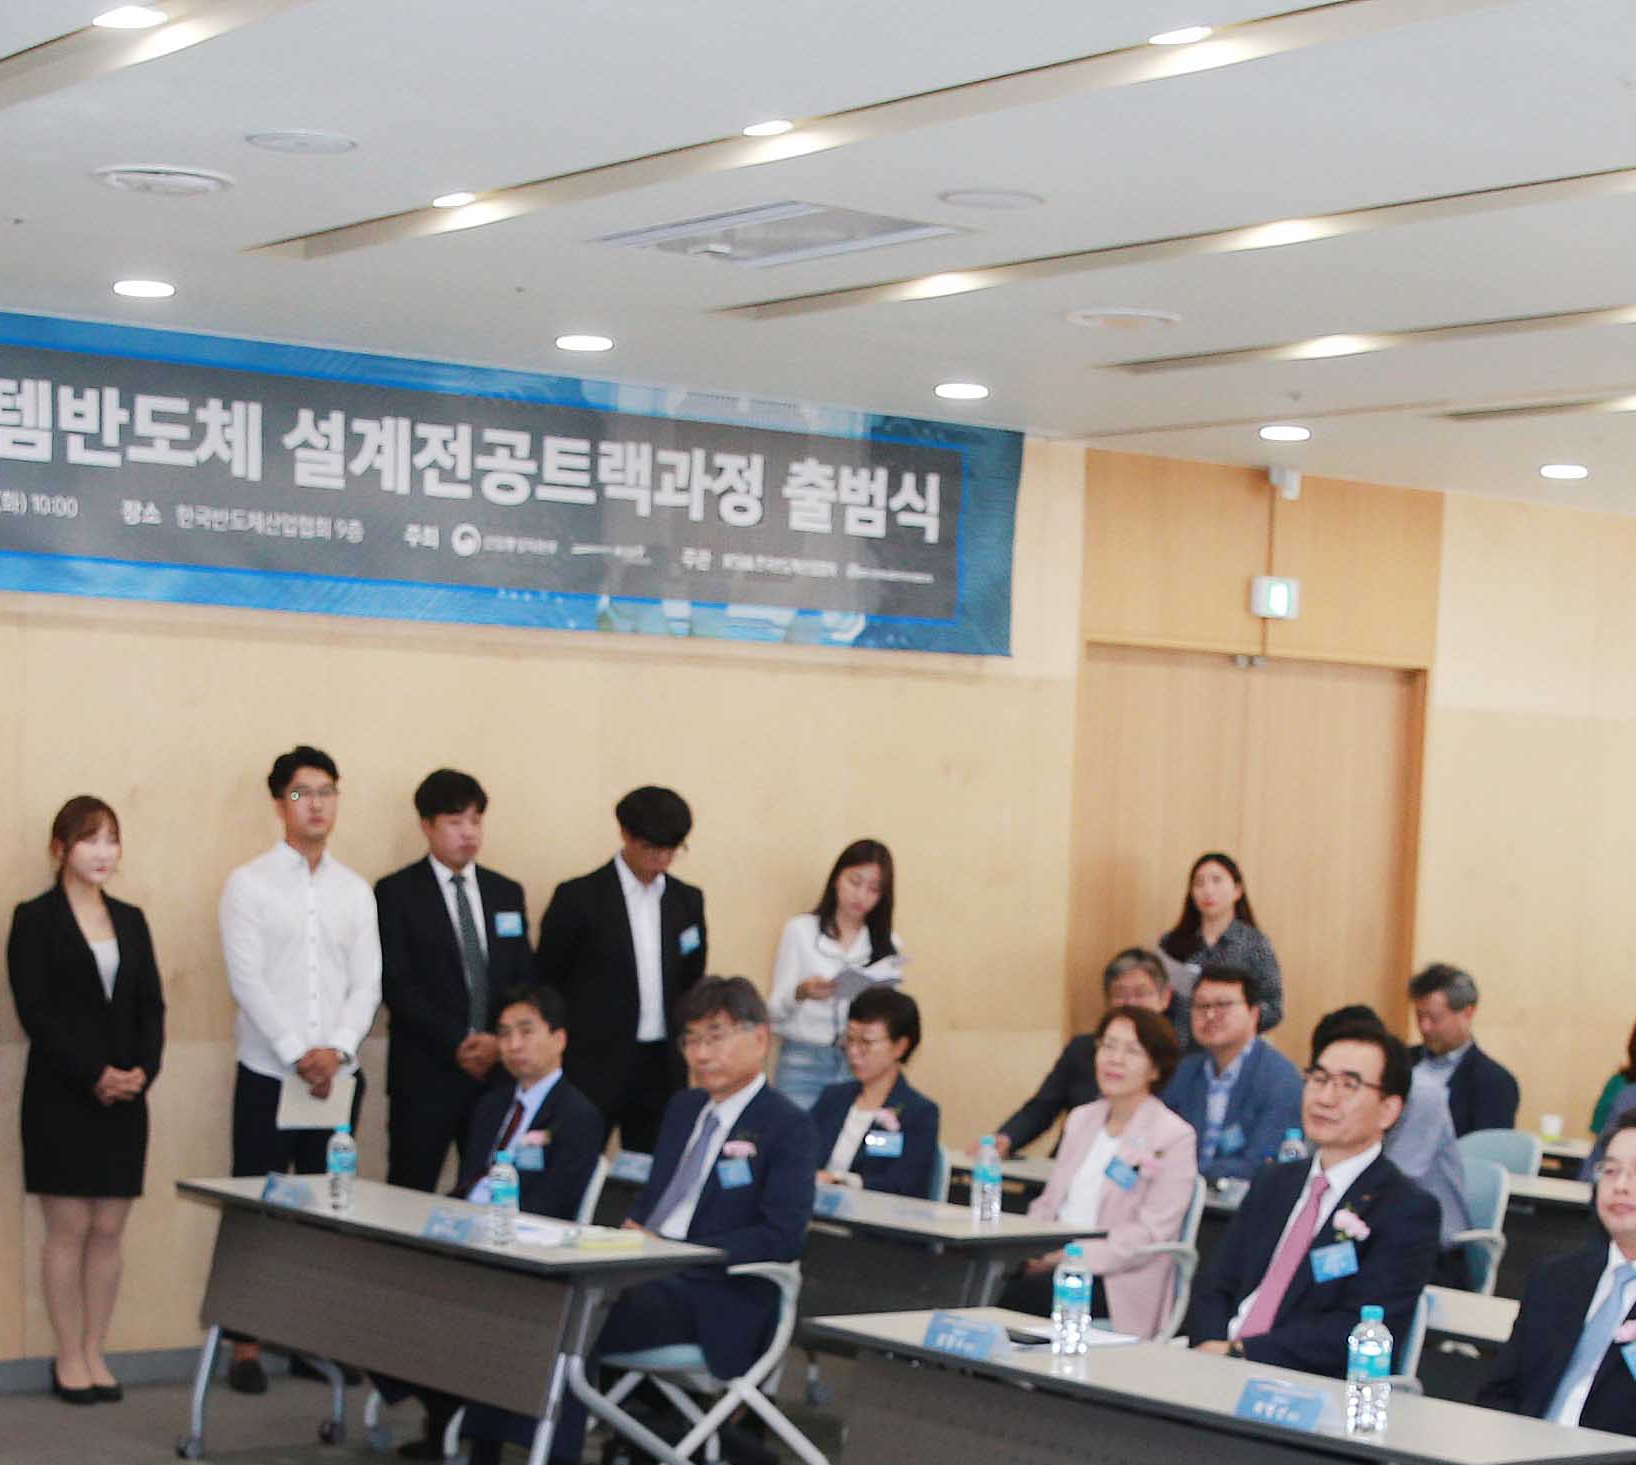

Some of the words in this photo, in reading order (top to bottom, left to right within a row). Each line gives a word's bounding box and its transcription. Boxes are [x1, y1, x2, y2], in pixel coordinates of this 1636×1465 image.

[31, 492, 79, 519] 10:00
[281, 408, 765, 528] 설계전공트랙과정
[781, 457, 940, 544] 출범식
